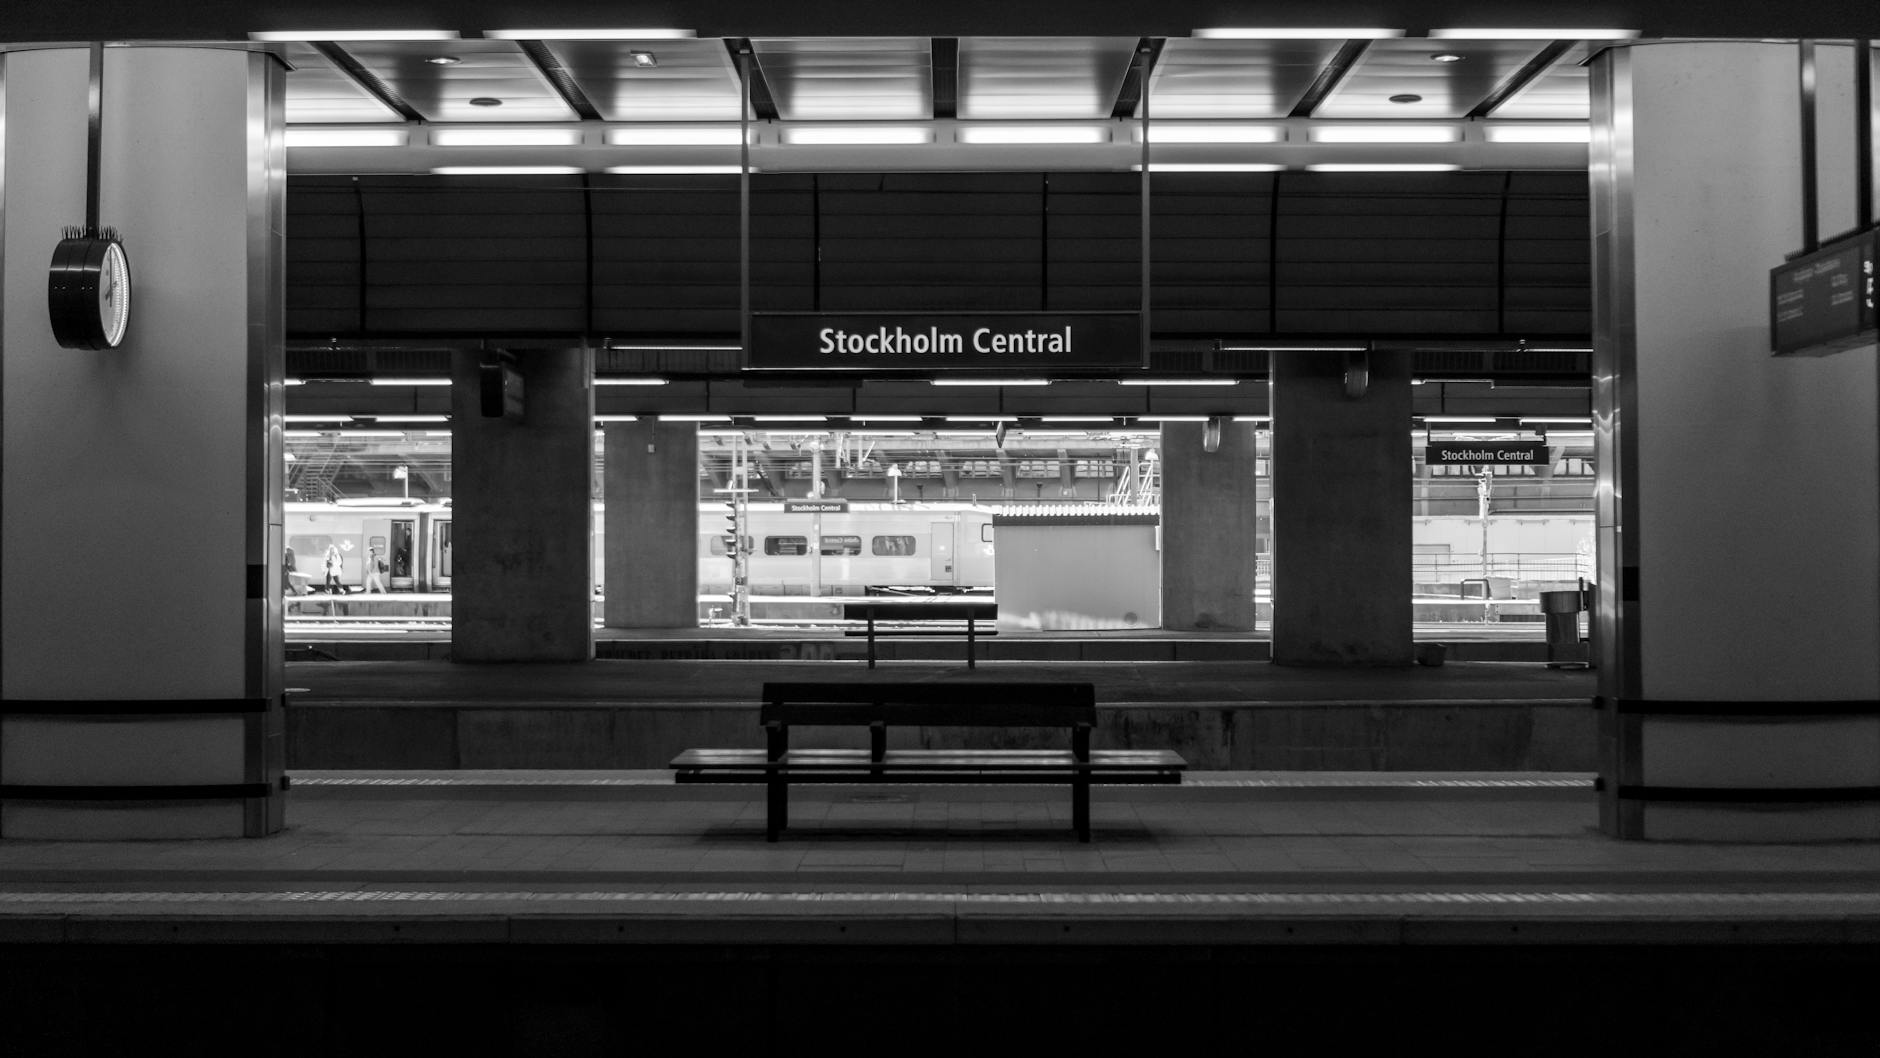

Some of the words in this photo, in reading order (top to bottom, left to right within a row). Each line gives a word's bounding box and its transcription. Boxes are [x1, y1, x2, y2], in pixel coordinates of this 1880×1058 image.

[819, 326, 963, 354] Stockholm
[972, 326, 1072, 353] Central
[1441, 449, 1494, 461] Stockholm
[1497, 449, 1534, 461] Central
[791, 504, 820, 512] Stockholm
[820, 504, 841, 512] Central
